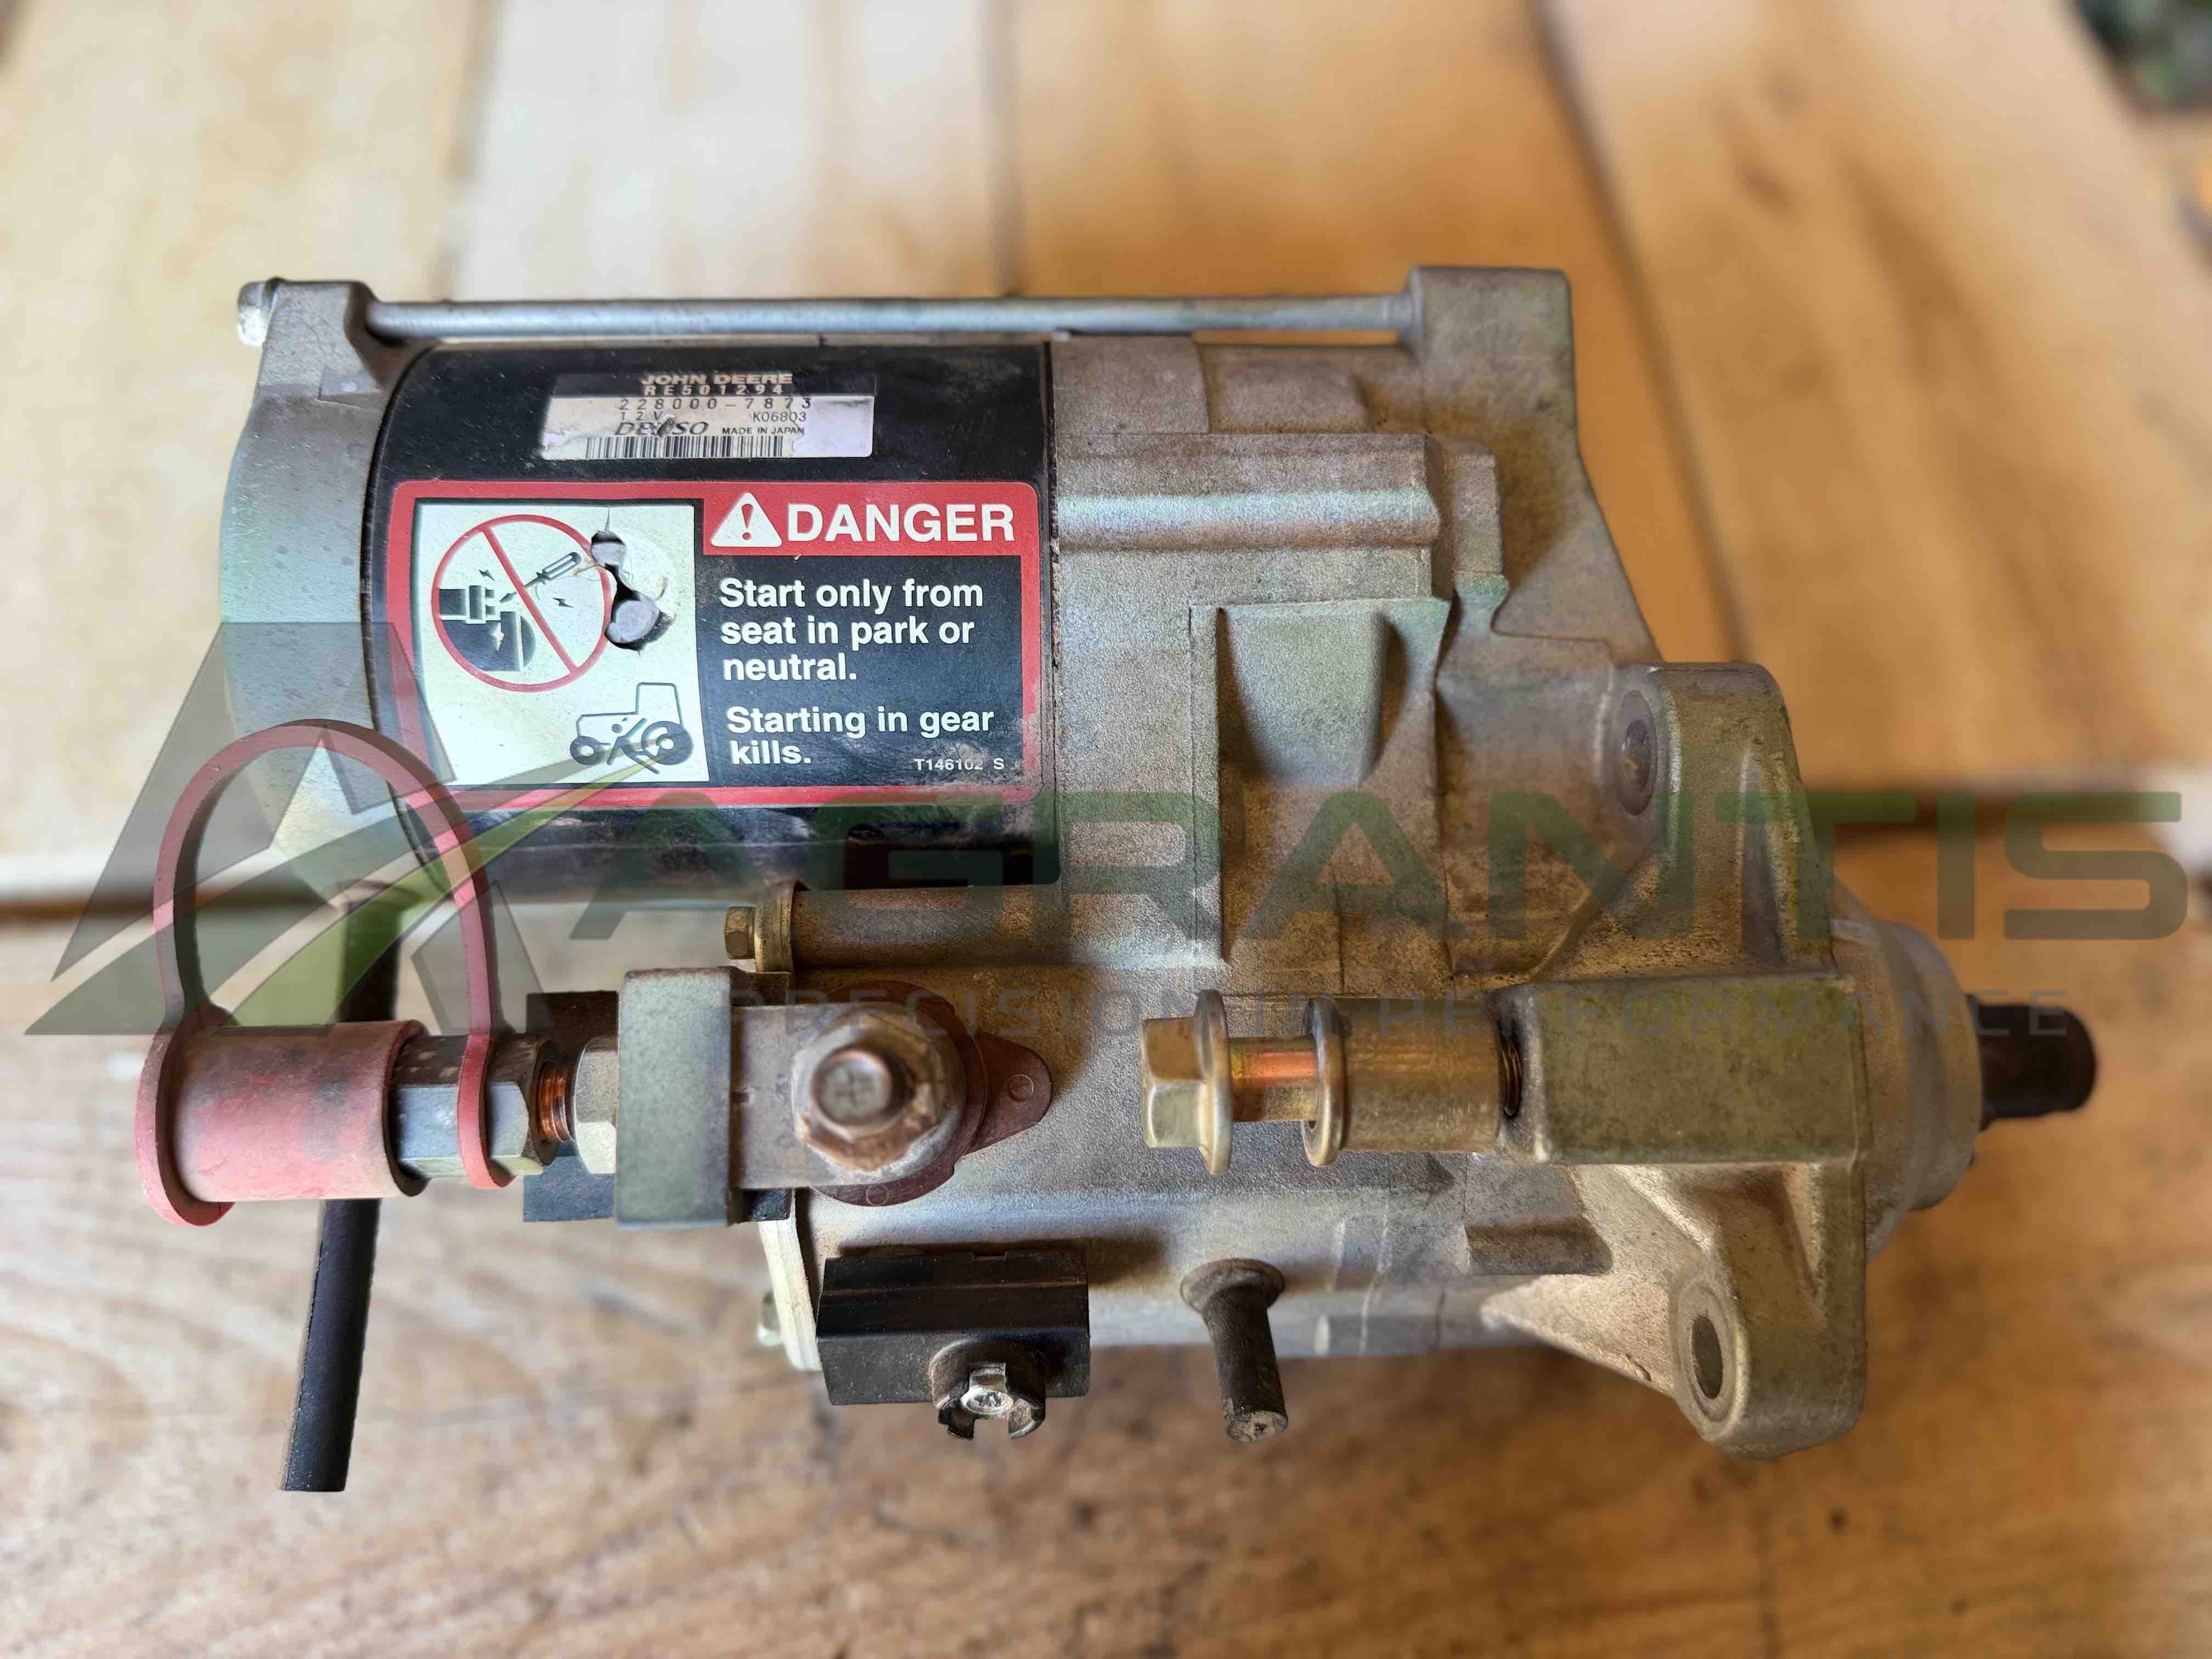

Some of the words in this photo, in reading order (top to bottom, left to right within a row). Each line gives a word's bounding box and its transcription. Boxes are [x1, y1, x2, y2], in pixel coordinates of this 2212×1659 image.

[641, 374, 707, 385] JOHN
[714, 374, 793, 385] DEERE
[787, 504, 1015, 542] DANGER
[719, 578, 805, 607] Start
[816, 579, 892, 614] only
[902, 578, 983, 607] from
[720, 617, 797, 645] seat
[808, 616, 838, 644] in
[851, 616, 929, 651] park
[939, 621, 975, 644] or
[723, 653, 857, 681] neutral.
[727, 706, 866, 738] Starting
[878, 707, 908, 732] in
[919, 710, 994, 738] gear
[730, 740, 811, 764] kills.
[913, 758, 984, 771] T146102
[993, 757, 1005, 770] S
